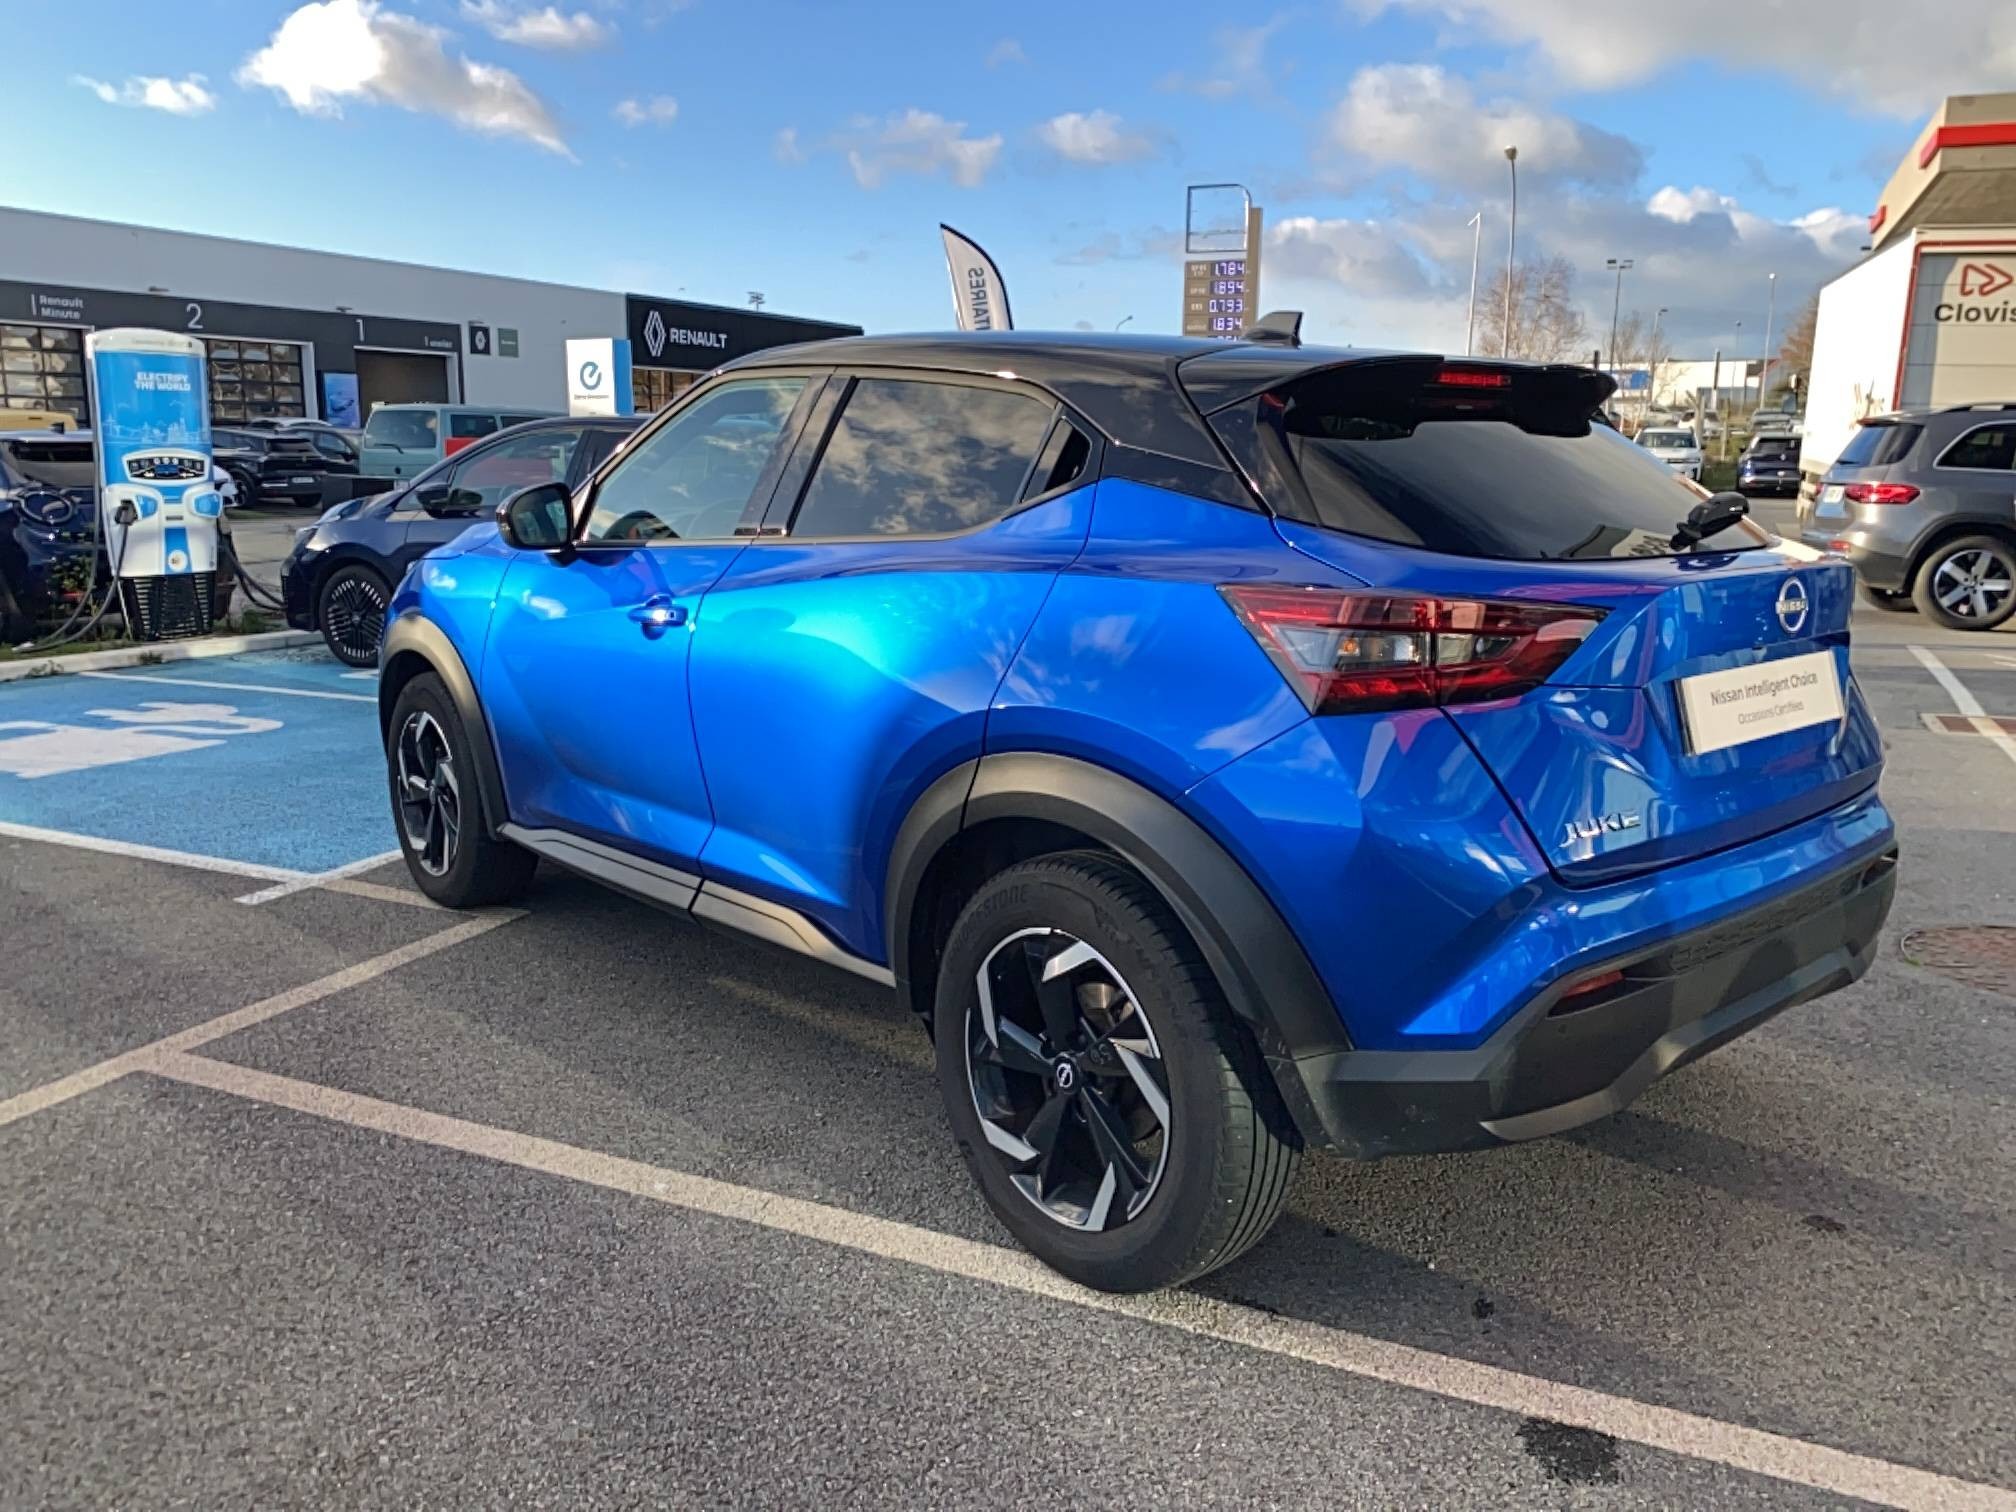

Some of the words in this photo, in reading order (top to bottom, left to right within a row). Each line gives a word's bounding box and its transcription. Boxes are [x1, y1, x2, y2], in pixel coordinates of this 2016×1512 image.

[39, 295, 84, 309] Renault
[186, 303, 204, 329] 2
[355, 318, 365, 342] 1
[669, 327, 728, 349] RENAULT
[1710, 688, 1744, 706] Nissan
[1744, 677, 1790, 697] Intelligent
[1790, 671, 1818, 689] Choice
[1559, 811, 1640, 847] JUKE
